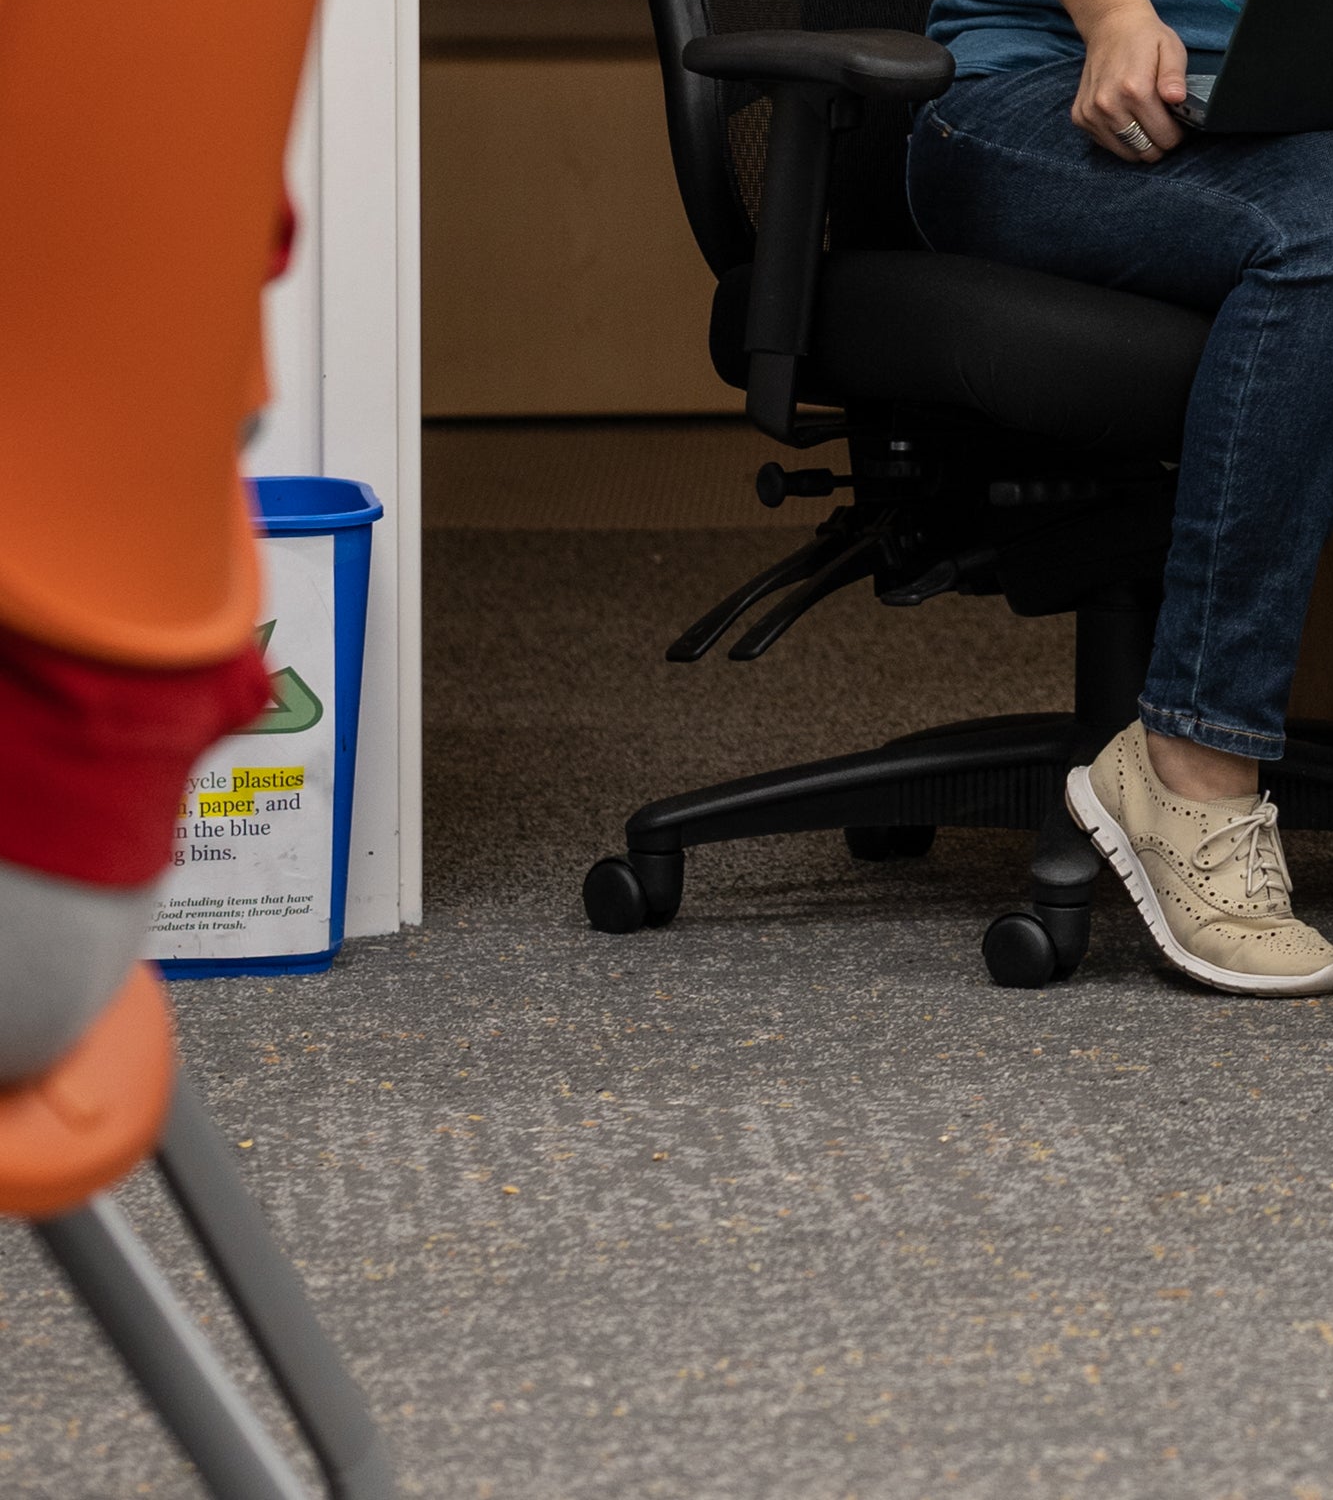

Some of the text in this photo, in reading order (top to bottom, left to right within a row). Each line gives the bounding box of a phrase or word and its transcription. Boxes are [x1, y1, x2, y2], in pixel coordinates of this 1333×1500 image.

[232, 770, 304, 792] plastics
[200, 799, 260, 817] paper,
[265, 793, 301, 812] and
[194, 820, 224, 838] the
[230, 819, 271, 837] blue
[190, 844, 237, 861] bins.
[169, 897, 225, 908] including
[227, 896, 258, 906] items
[261, 895, 284, 904] that
[286, 894, 314, 904] have
[185, 909, 245, 919] remnants;
[247, 907, 282, 917] throw
[282, 905, 313, 918] food-
[198, 921, 209, 930] in
[212, 920, 247, 930] trash.
